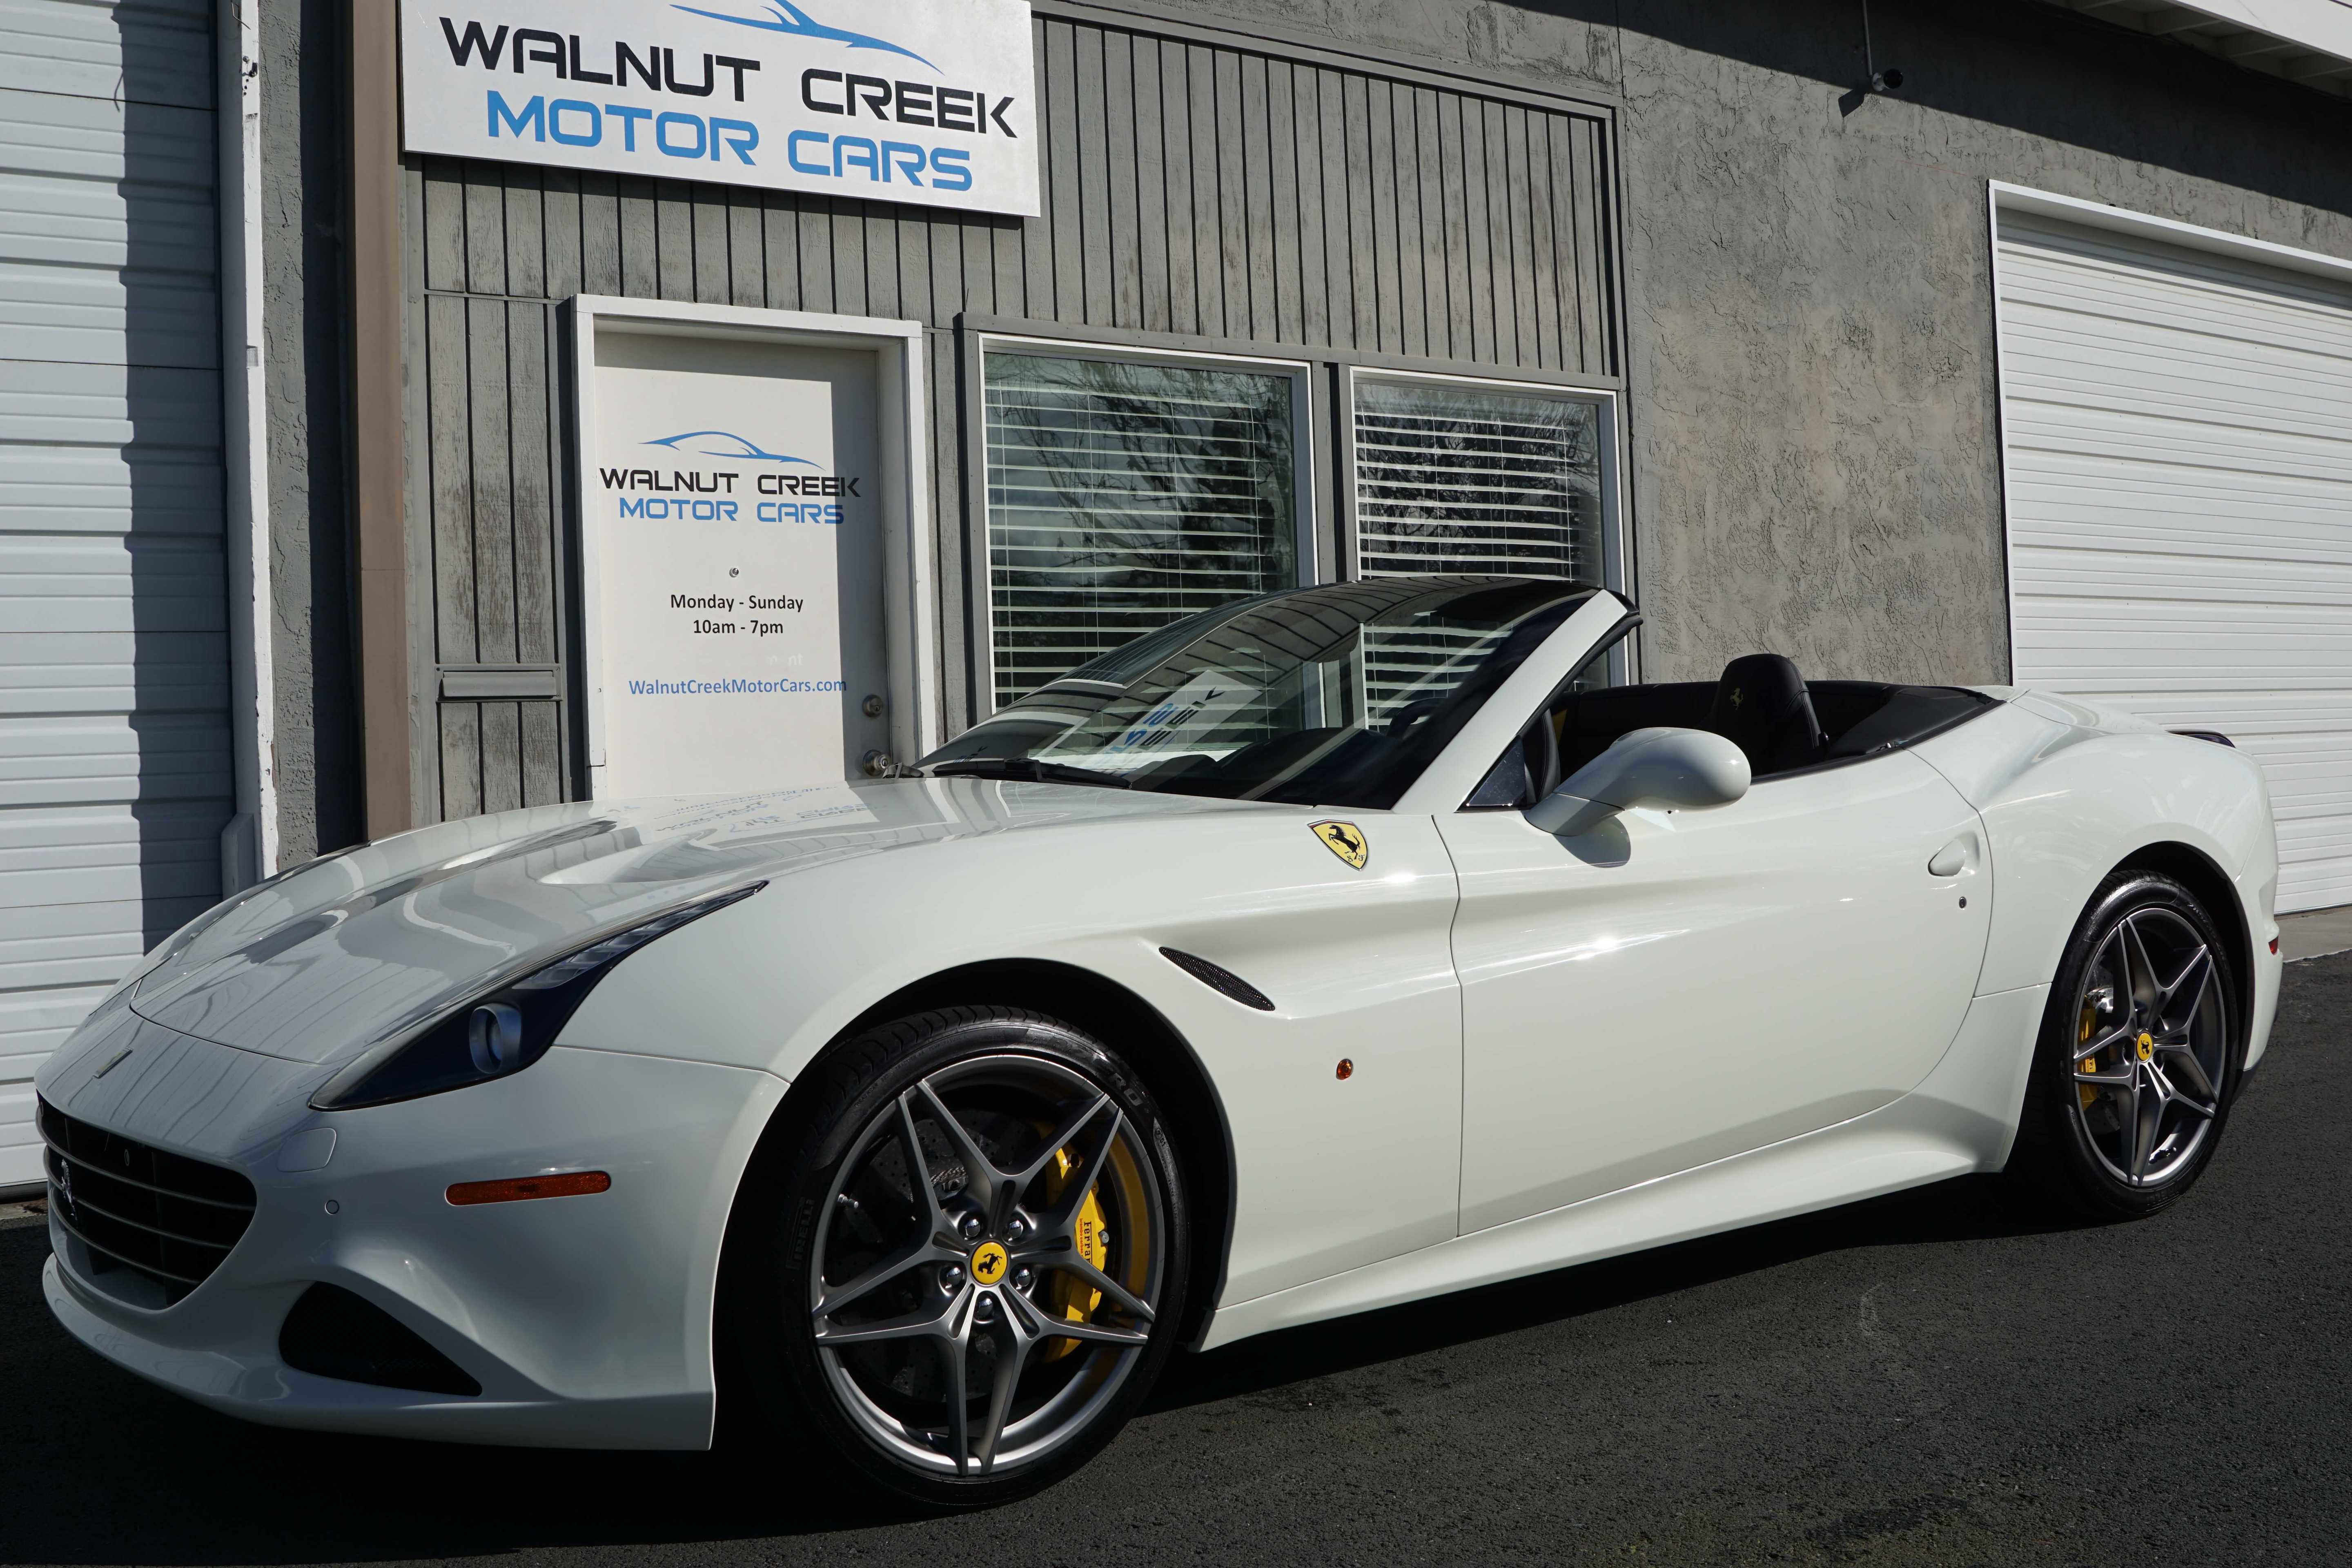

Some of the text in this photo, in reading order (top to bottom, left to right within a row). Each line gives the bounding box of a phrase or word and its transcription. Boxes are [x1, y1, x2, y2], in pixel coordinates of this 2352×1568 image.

[439, 17, 1017, 138] WALNUT CREEK
[487, 90, 972, 191] MOTOR CARS
[599, 468, 861, 497] WALNUT CREEK
[620, 497, 844, 524] MOTOR CARS
[671, 594, 734, 612] Monday
[749, 595, 803, 612] Sunday
[694, 619, 735, 634] 10am
[750, 620, 783, 637] 7pm
[628, 679, 847, 695] WalnutCreekMotorCars.com
